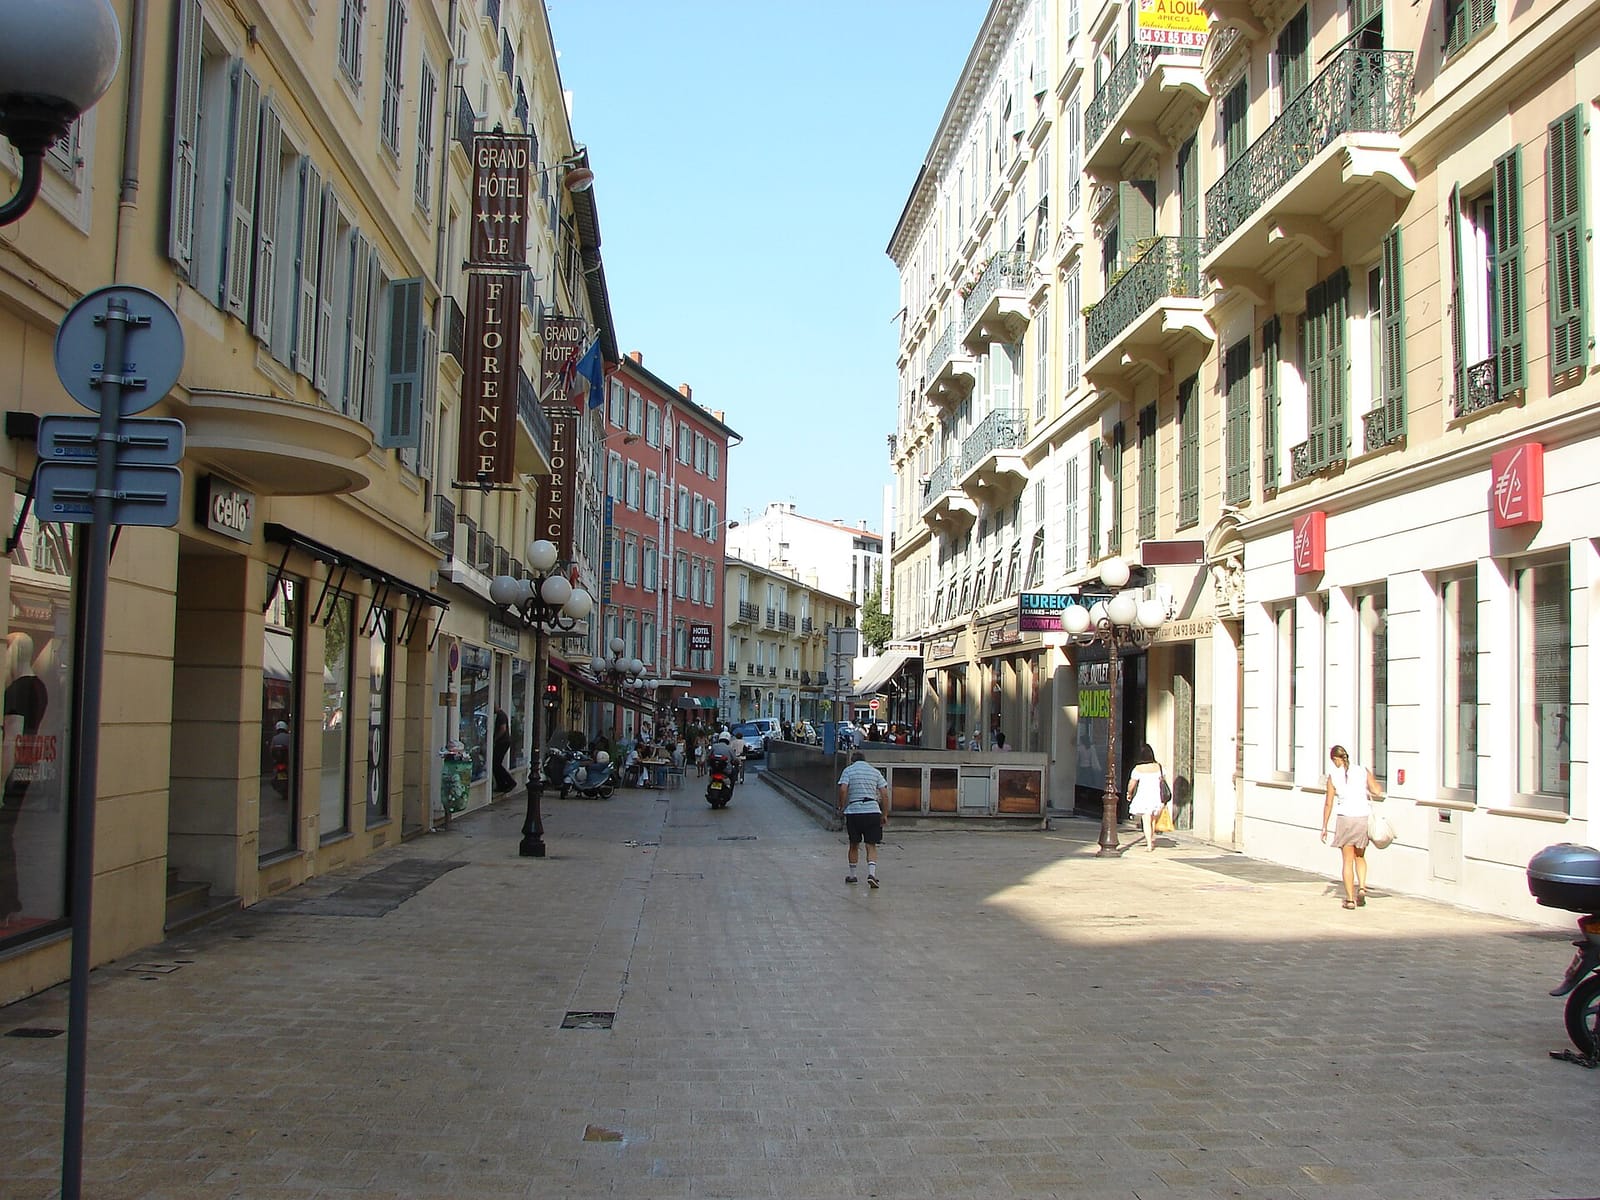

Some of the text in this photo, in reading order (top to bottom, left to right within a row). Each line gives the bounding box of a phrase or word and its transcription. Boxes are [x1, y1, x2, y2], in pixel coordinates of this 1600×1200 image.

[478, 148, 526, 169] GRAND
[478, 172, 523, 198] HÔTEL
[487, 237, 509, 254] LE
[544, 326, 579, 341] GRAND
[478, 283, 503, 473] FLORENCE
[552, 389, 567, 401] LE
[214, 491, 247, 531] celio
[1021, 594, 1076, 609] EUREKA
[692, 627, 709, 635] HOTEL
[1079, 689, 1110, 718] SOLDES
